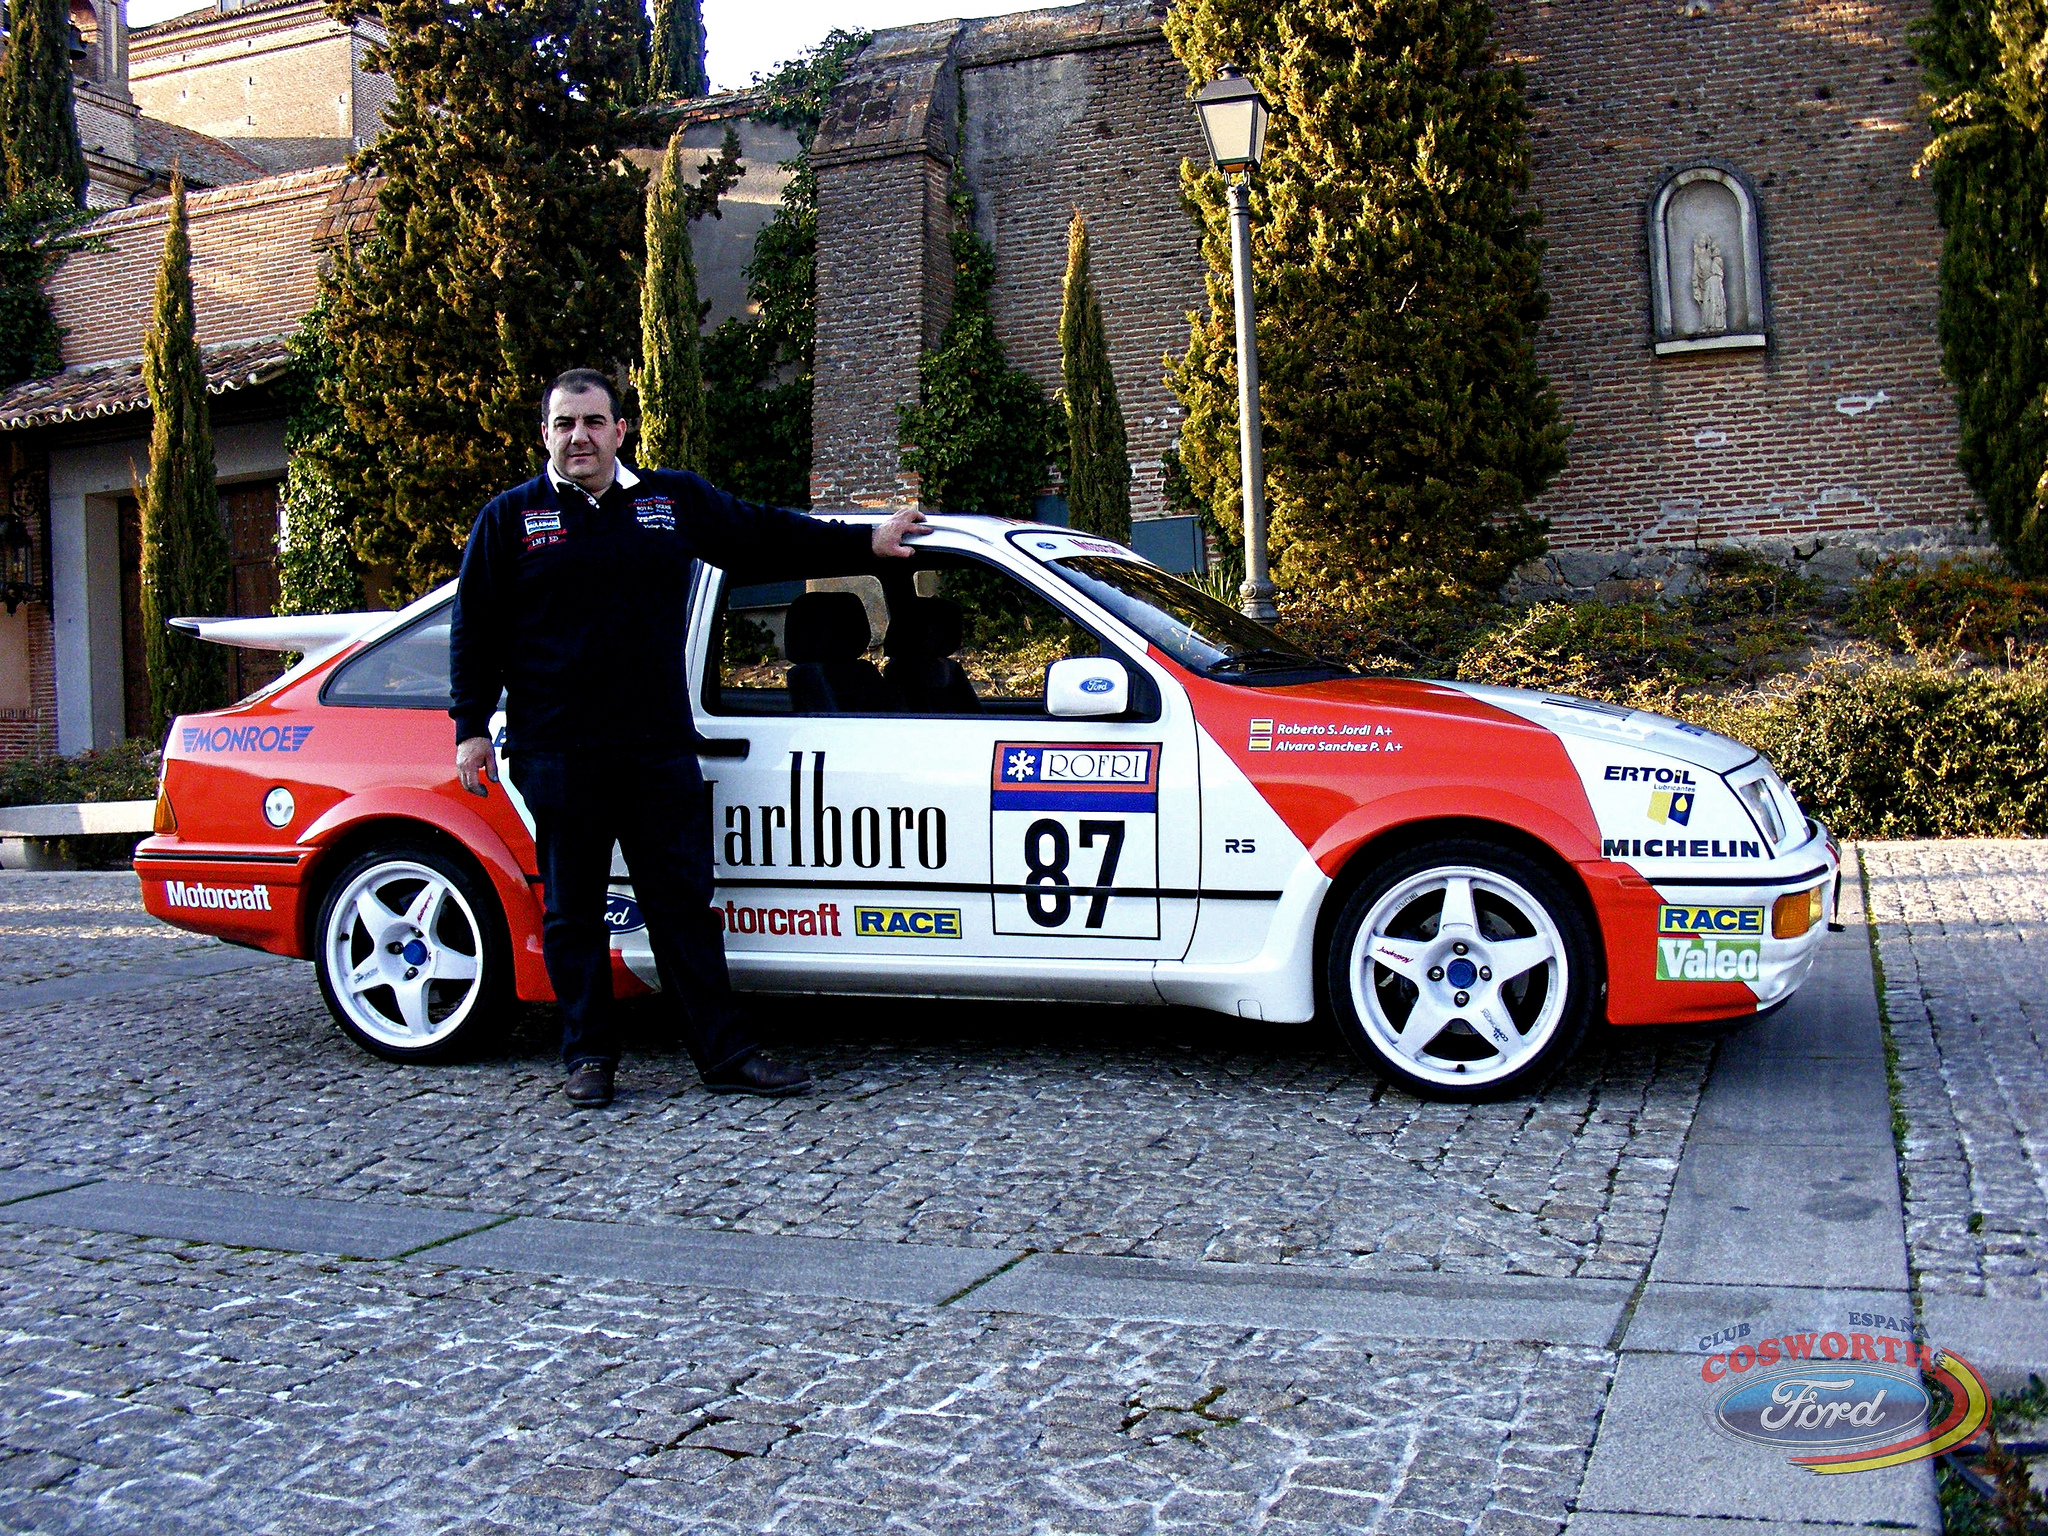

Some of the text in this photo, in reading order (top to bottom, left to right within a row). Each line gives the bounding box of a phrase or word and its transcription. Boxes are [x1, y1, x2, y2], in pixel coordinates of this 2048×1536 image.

[1086, 679, 1108, 691] Ford
[192, 726, 292, 752] MONROE
[1277, 724, 1393, 736] Roberto S. Jordi A+
[1276, 741, 1403, 752] Alvaro Sanchez P. A+
[1048, 754, 1140, 778] ROFRI
[1653, 783, 1696, 792] Lubricantes
[1225, 839, 1256, 854] RS
[1603, 839, 1760, 858] MICHELIN
[1024, 818, 1125, 928] 87
[165, 880, 272, 911] Motorcraft
[603, 900, 630, 925] rd
[861, 911, 957, 935] RACE
[1664, 908, 1760, 931] RACE
[1659, 939, 1759, 980] Valeo
